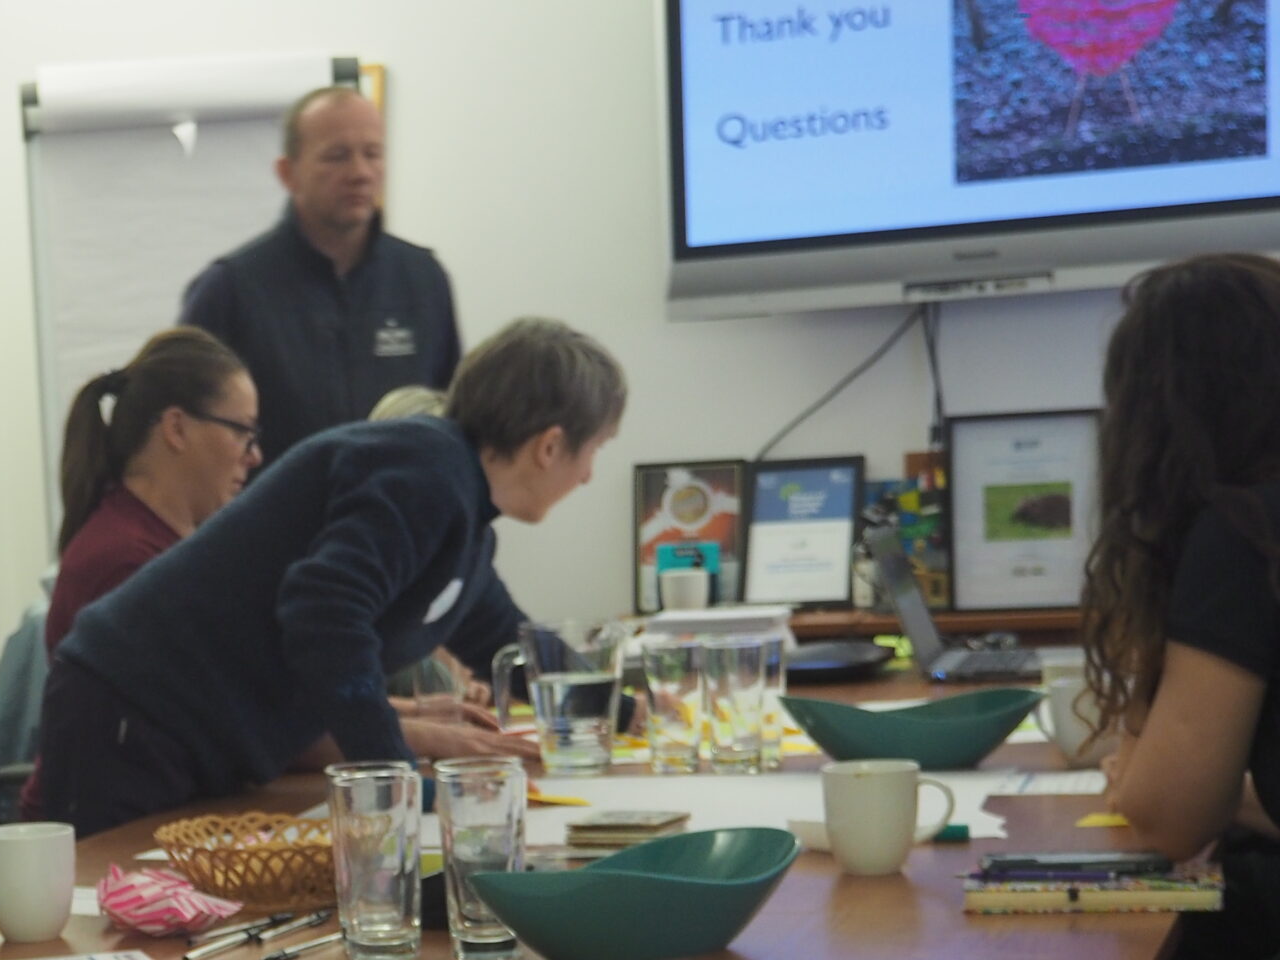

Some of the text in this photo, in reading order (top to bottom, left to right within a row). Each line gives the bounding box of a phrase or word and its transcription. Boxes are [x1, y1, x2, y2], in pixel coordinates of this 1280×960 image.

[715, 4, 891, 46] Thank you
[715, 104, 890, 149] Questions
